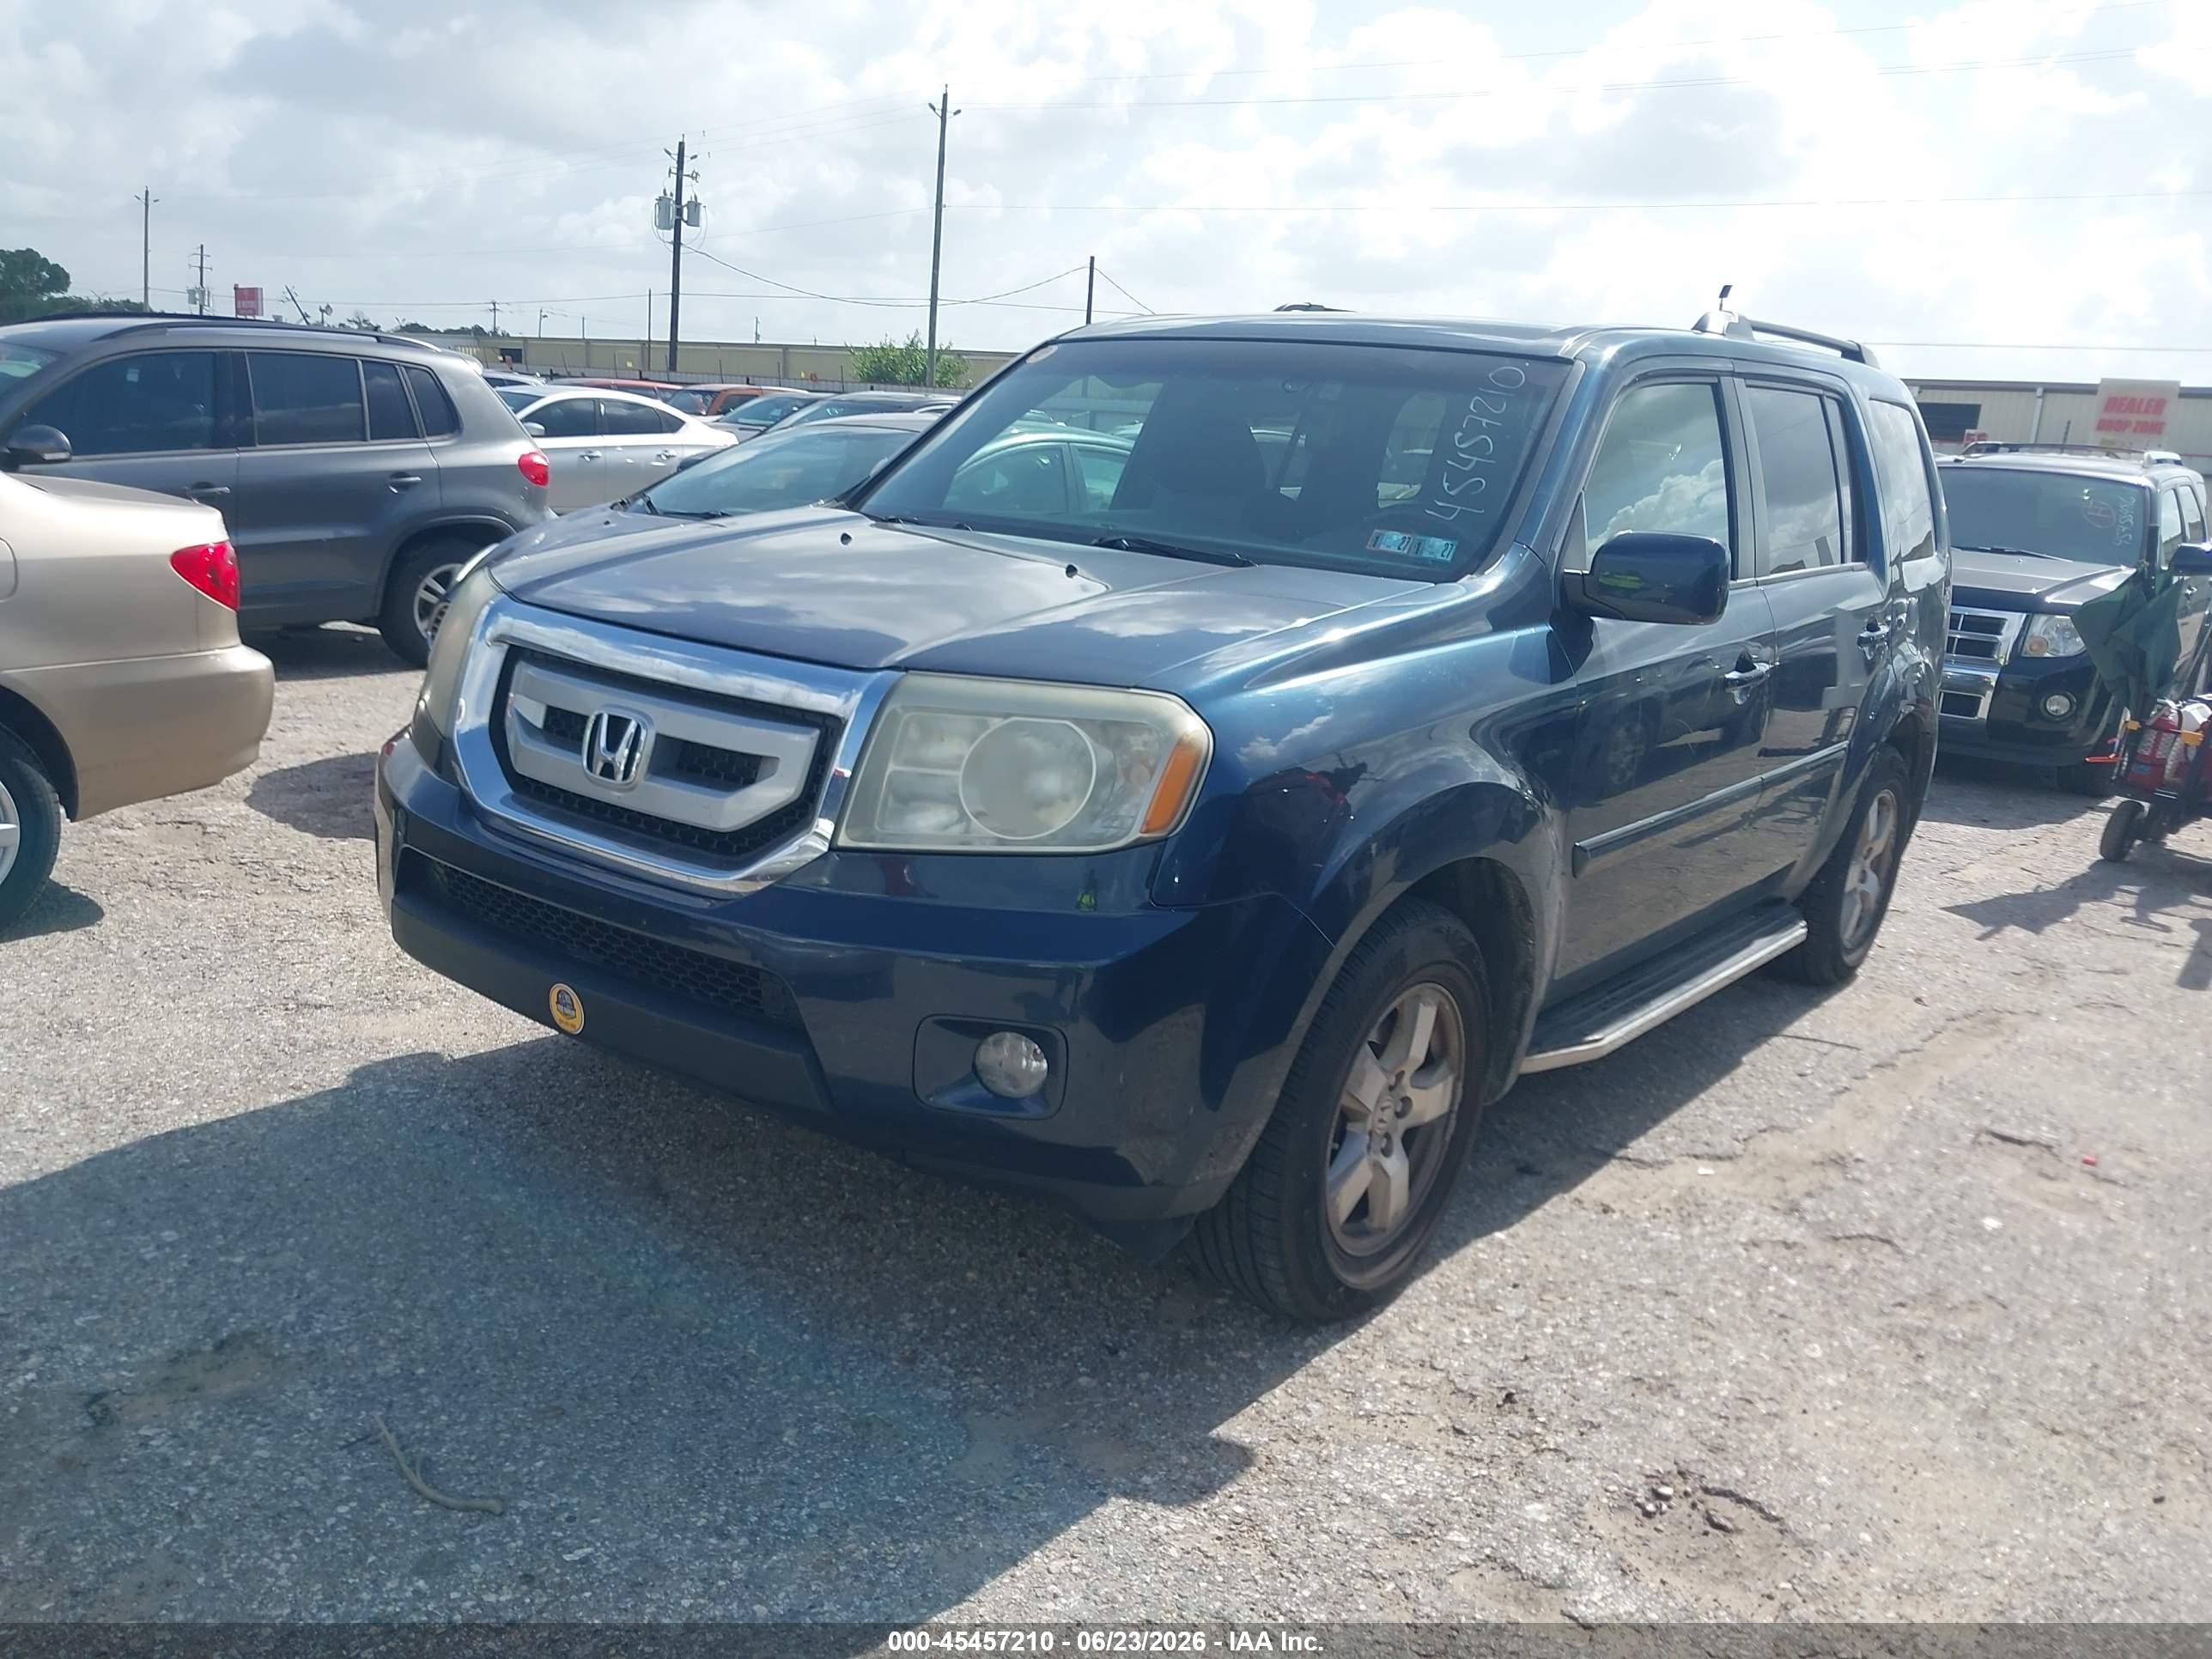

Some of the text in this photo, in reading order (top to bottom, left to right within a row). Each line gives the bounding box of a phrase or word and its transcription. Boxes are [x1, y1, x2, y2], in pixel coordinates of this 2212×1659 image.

[2103, 397, 2167, 415] DEALER
[1425, 366, 1525, 520] 45457210
[1397, 536, 1411, 550] 27
[1441, 542, 1455, 558] 27
